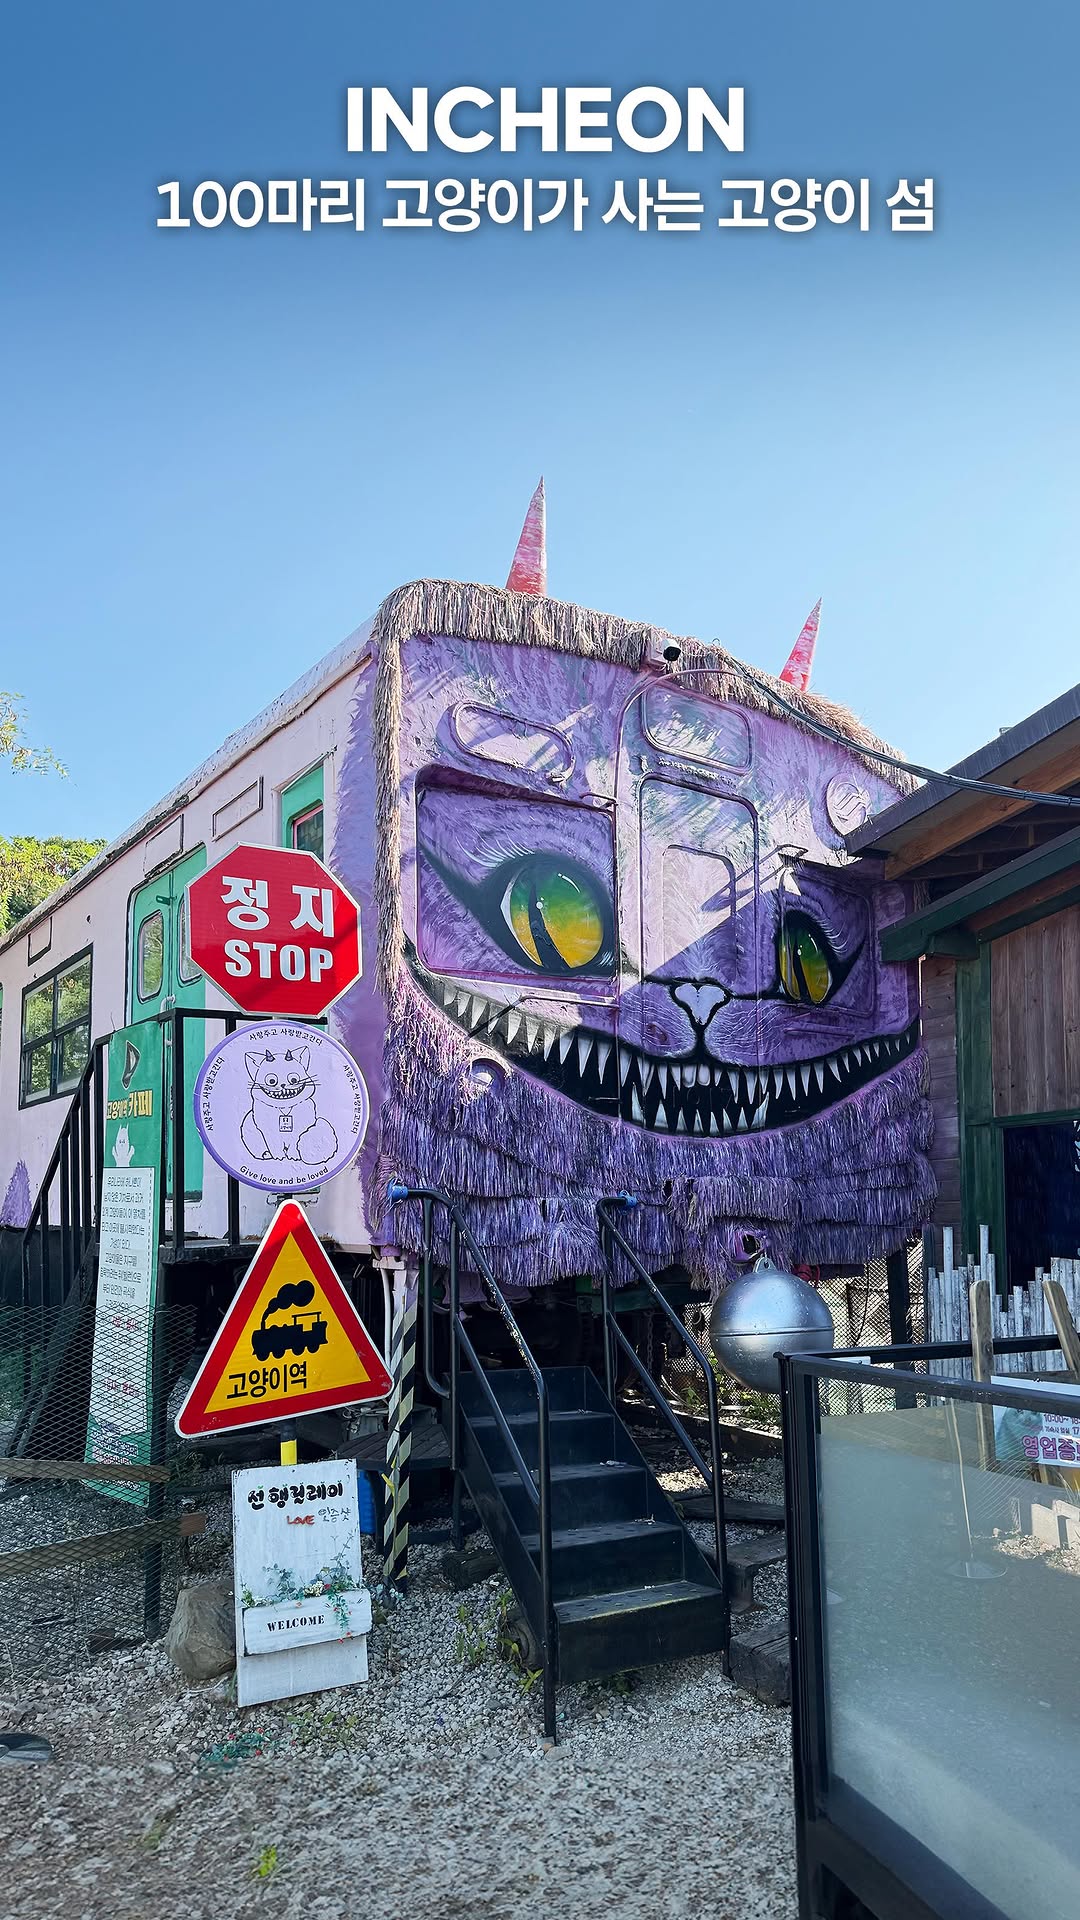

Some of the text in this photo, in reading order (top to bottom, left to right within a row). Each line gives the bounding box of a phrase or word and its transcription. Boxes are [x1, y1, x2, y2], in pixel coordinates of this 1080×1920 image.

[224, 939, 333, 982] STOP
[249, 1028, 323, 1046] 사랑주고 사랑받고간다
[128, 1089, 153, 1117] 카페
[240, 1165, 330, 1185] Give love and be loved
[226, 1361, 308, 1399] 고양이역
[1022, 1435, 1080, 1461] 영업종
[286, 1515, 316, 1526] LOVE
[318, 1506, 352, 1523] 인증샷
[266, 1614, 325, 1632] WELCOME
